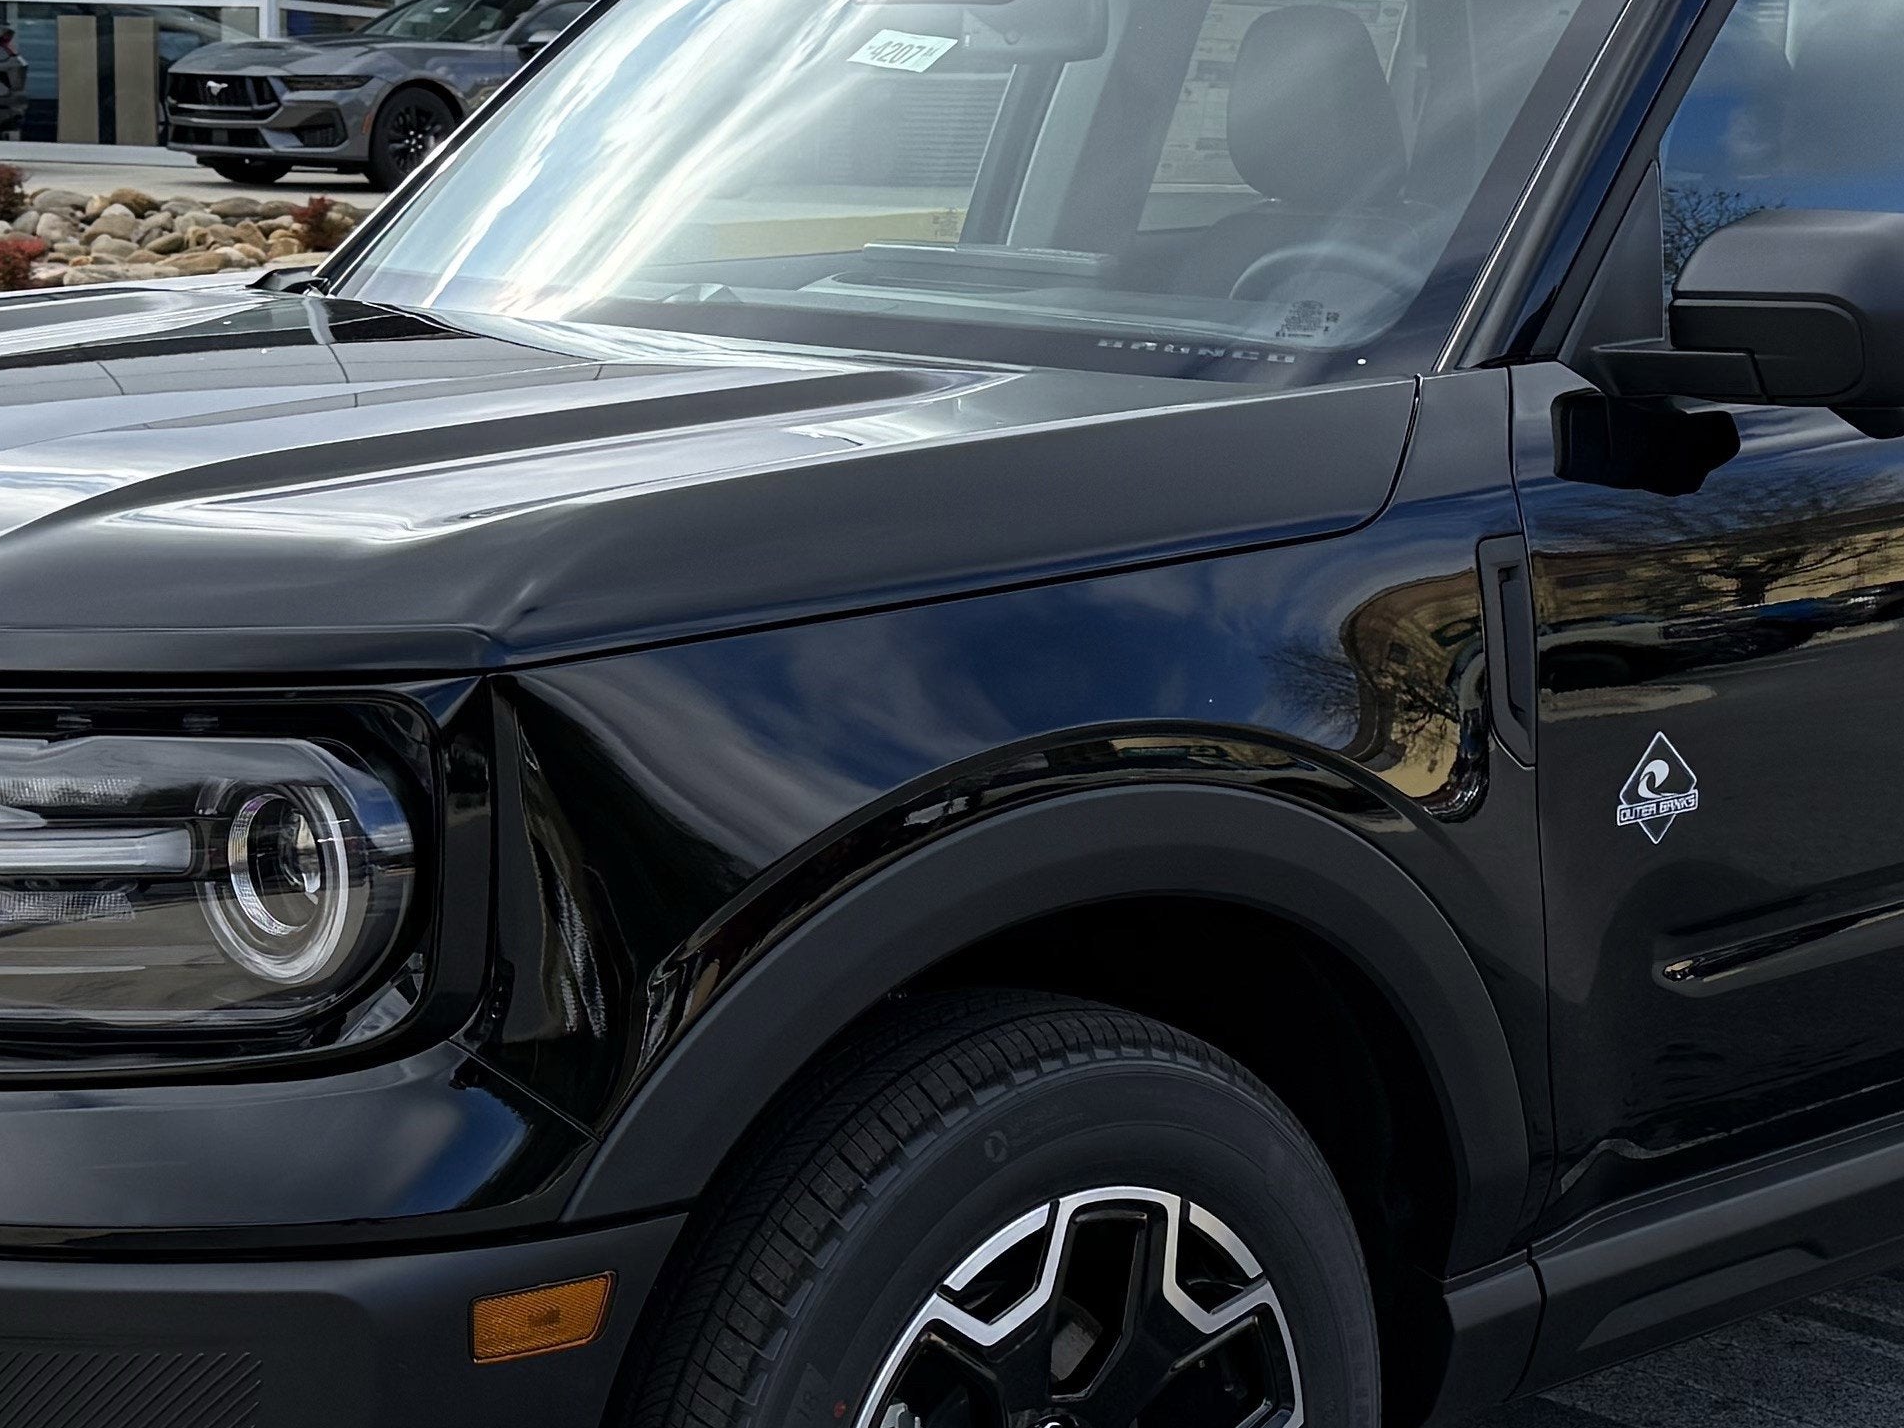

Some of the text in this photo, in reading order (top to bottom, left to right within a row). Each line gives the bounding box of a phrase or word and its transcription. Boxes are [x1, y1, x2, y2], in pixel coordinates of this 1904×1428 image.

[870, 40, 927, 65] 4207
[1620, 794, 1695, 822] OUTER BANKS
